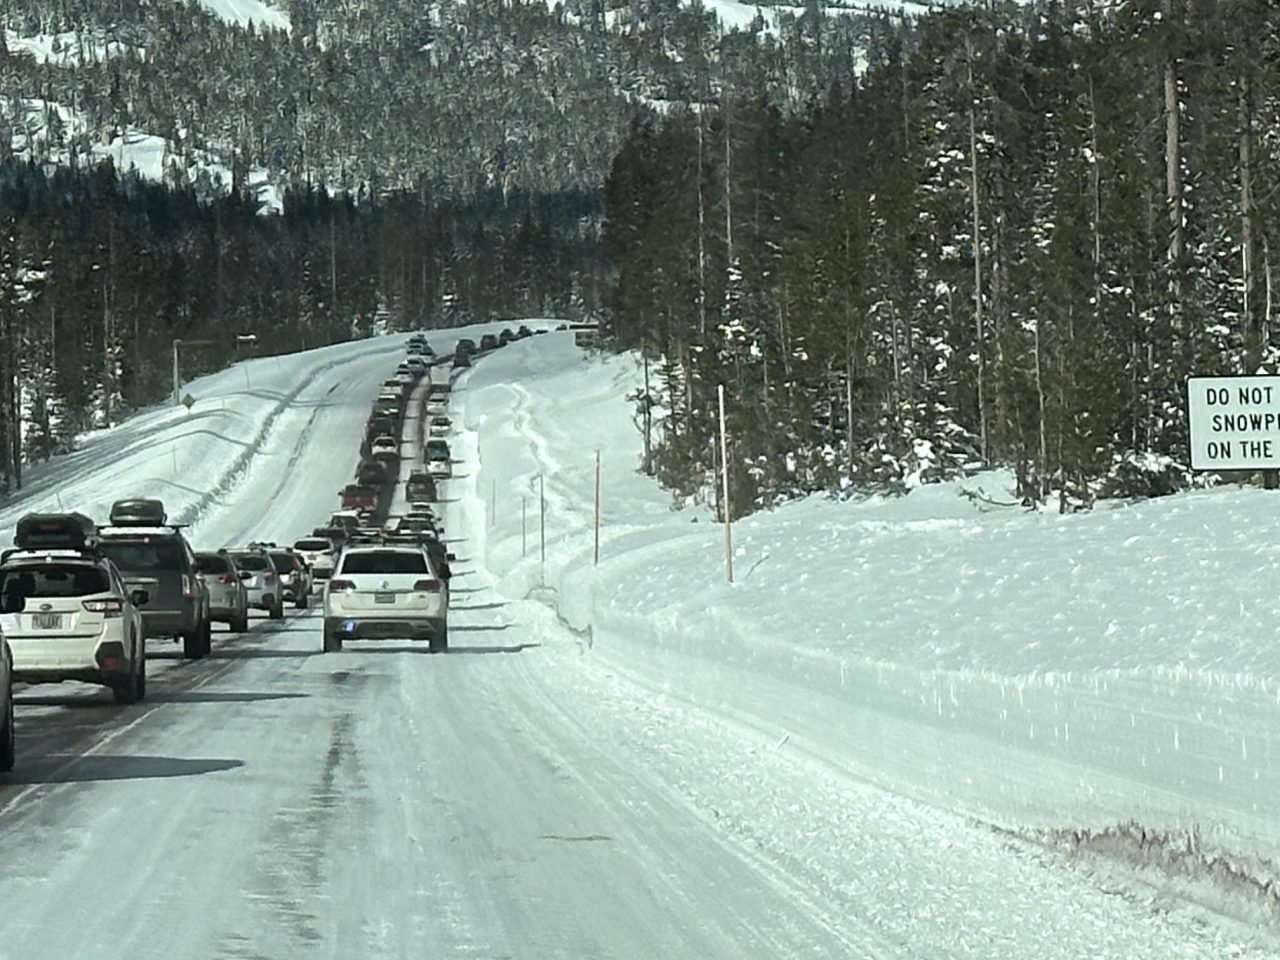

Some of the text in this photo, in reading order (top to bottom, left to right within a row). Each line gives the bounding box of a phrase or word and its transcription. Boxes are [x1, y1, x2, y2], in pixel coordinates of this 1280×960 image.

[1207, 387, 1272, 405] DO NOT
[1207, 440, 1273, 459] ON THE
